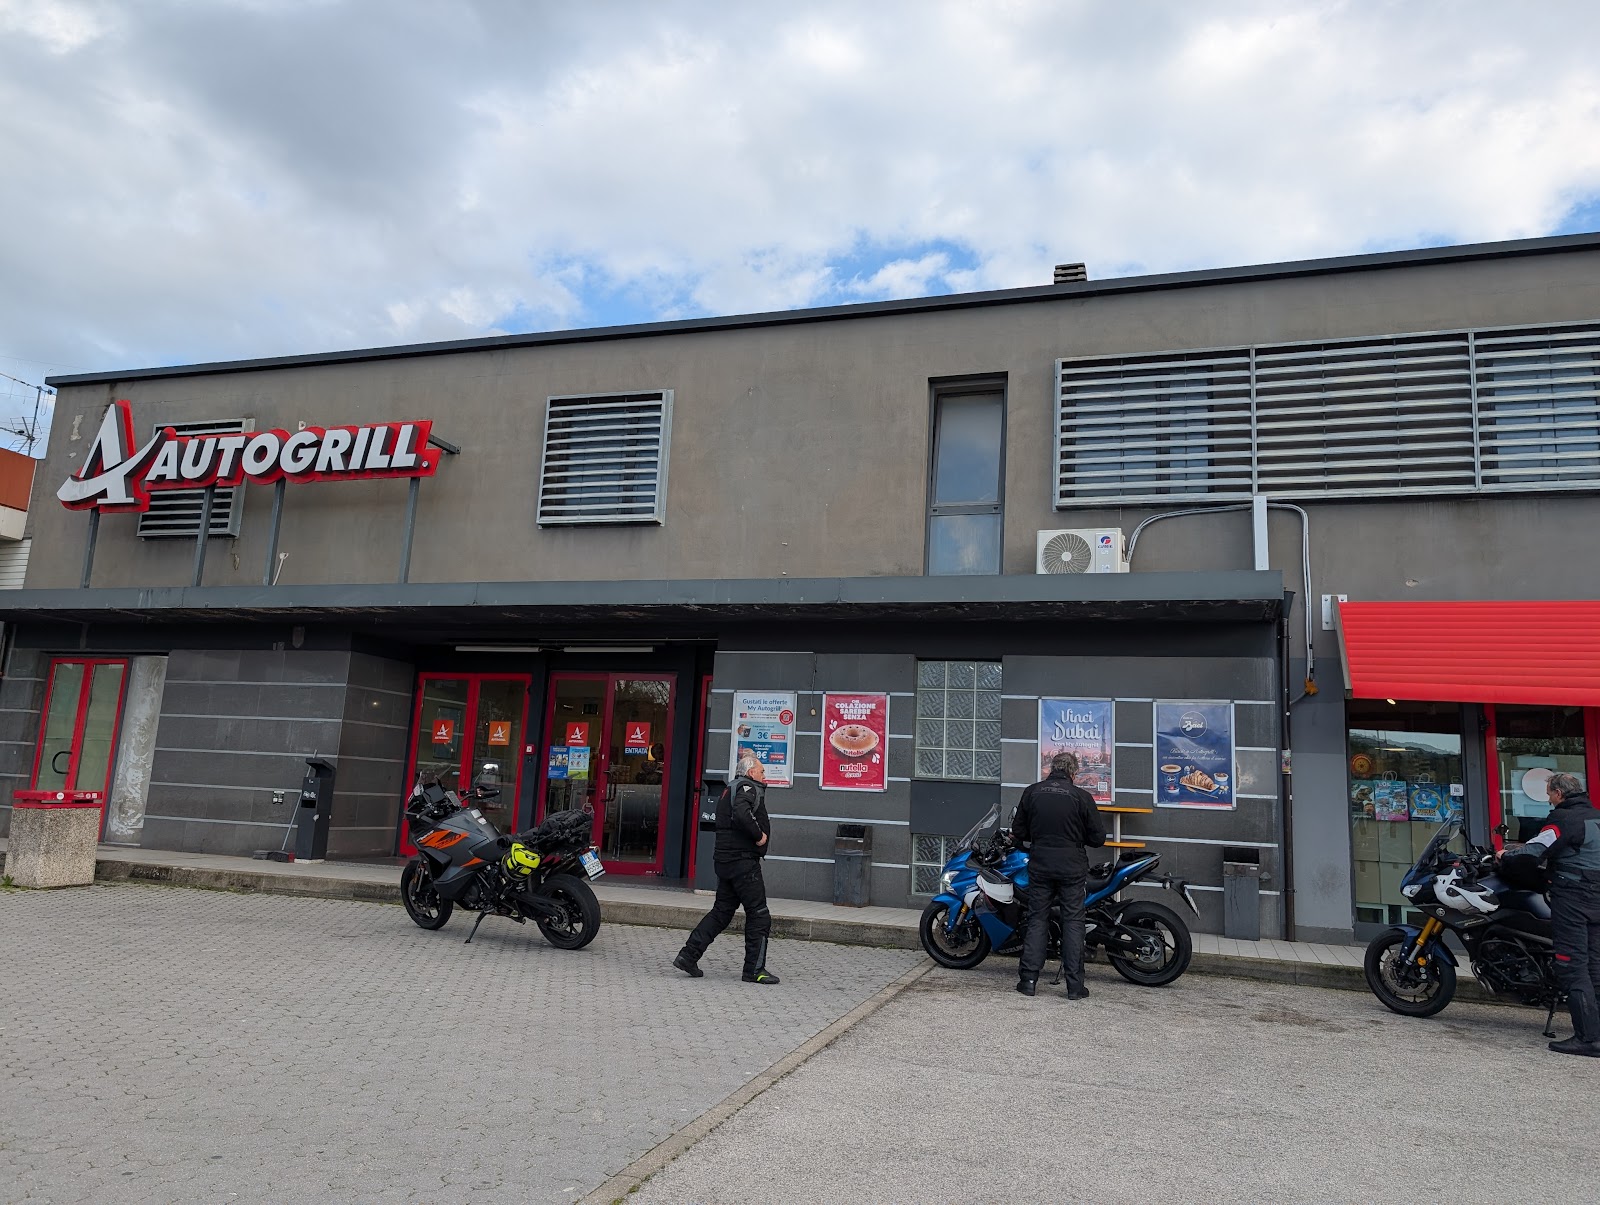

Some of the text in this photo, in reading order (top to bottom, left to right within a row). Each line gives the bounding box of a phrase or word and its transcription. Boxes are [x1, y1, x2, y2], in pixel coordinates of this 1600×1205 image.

[145, 424, 419, 482] AUTOGRILL
[1060, 708, 1095, 724] Vinci
[1051, 719, 1102, 742] Dubai
[757, 731, 769, 740] 3€
[624, 747, 648, 755] ENTRATA
[756, 751, 768, 759] 8€
[840, 763, 867, 772] nutella
[998, 944, 1024, 954] SUZUK
